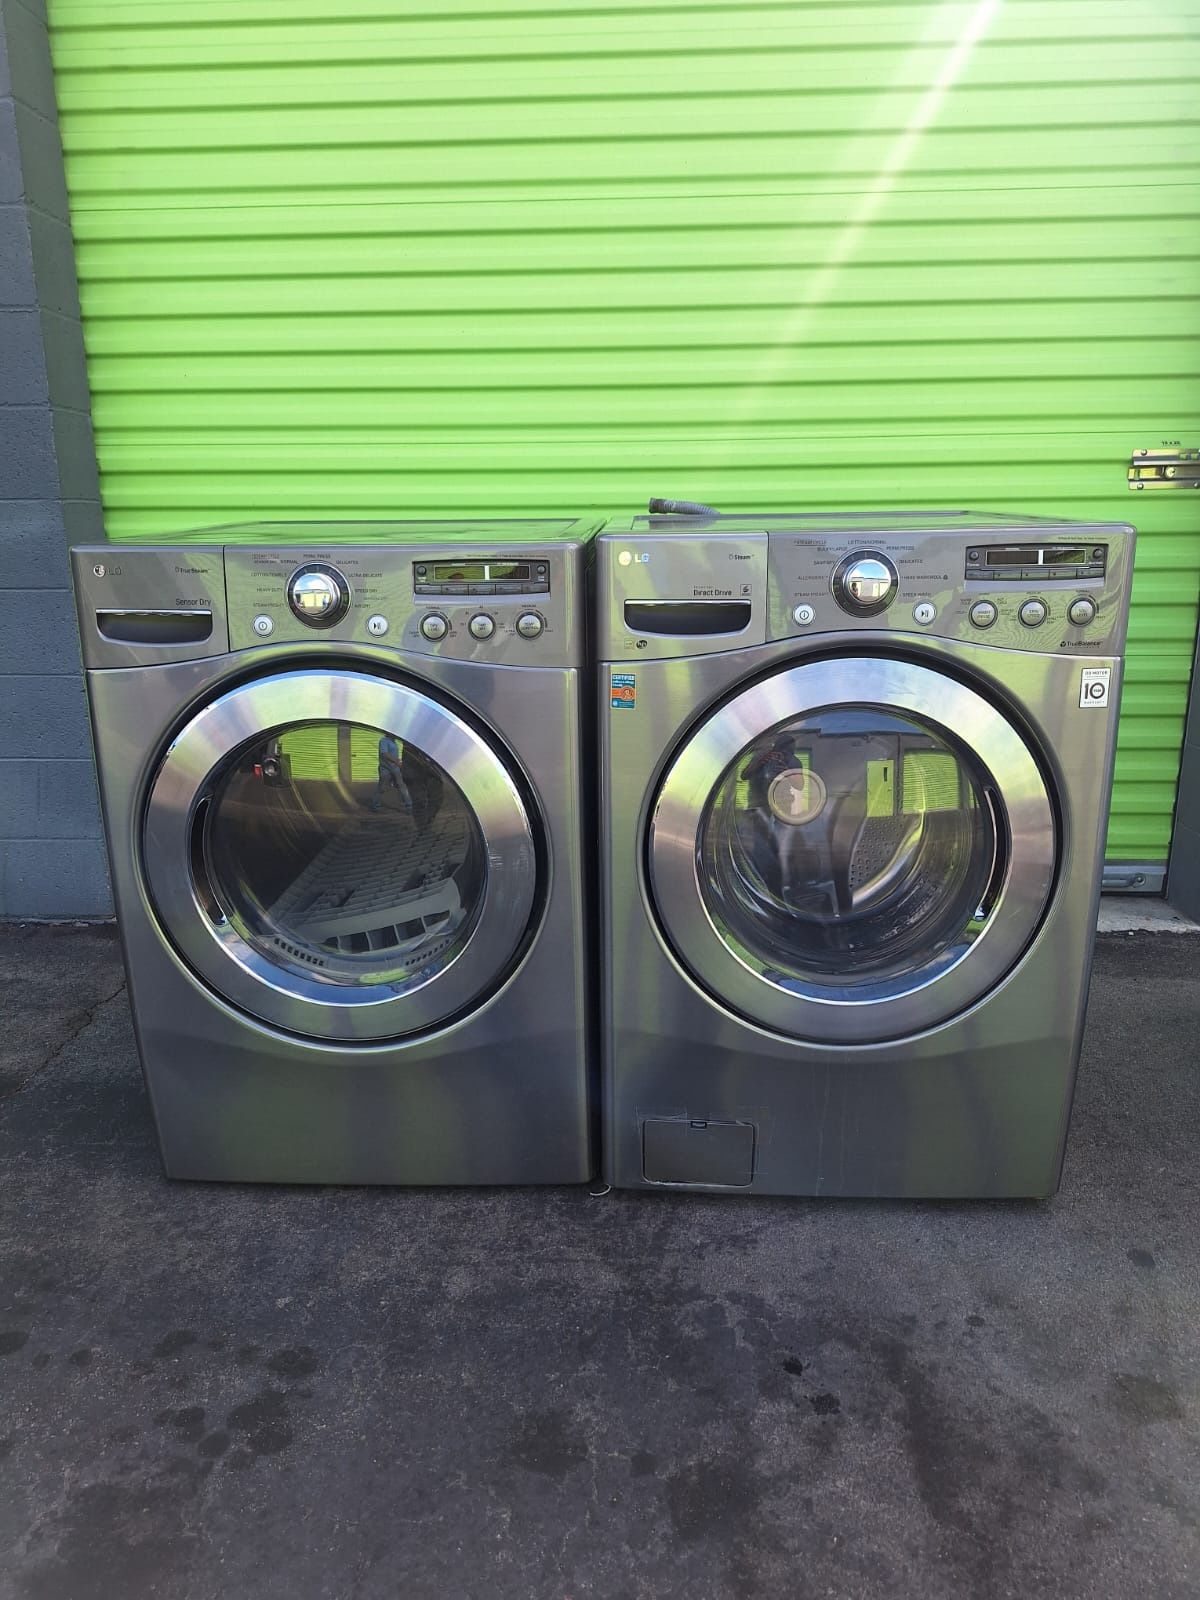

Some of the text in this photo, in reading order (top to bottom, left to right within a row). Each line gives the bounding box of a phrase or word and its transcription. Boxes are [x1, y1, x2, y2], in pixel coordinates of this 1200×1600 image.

[634, 552, 650, 563] LG
[175, 598, 212, 608] Sensor Dry
[1084, 682, 1106, 699] 10
